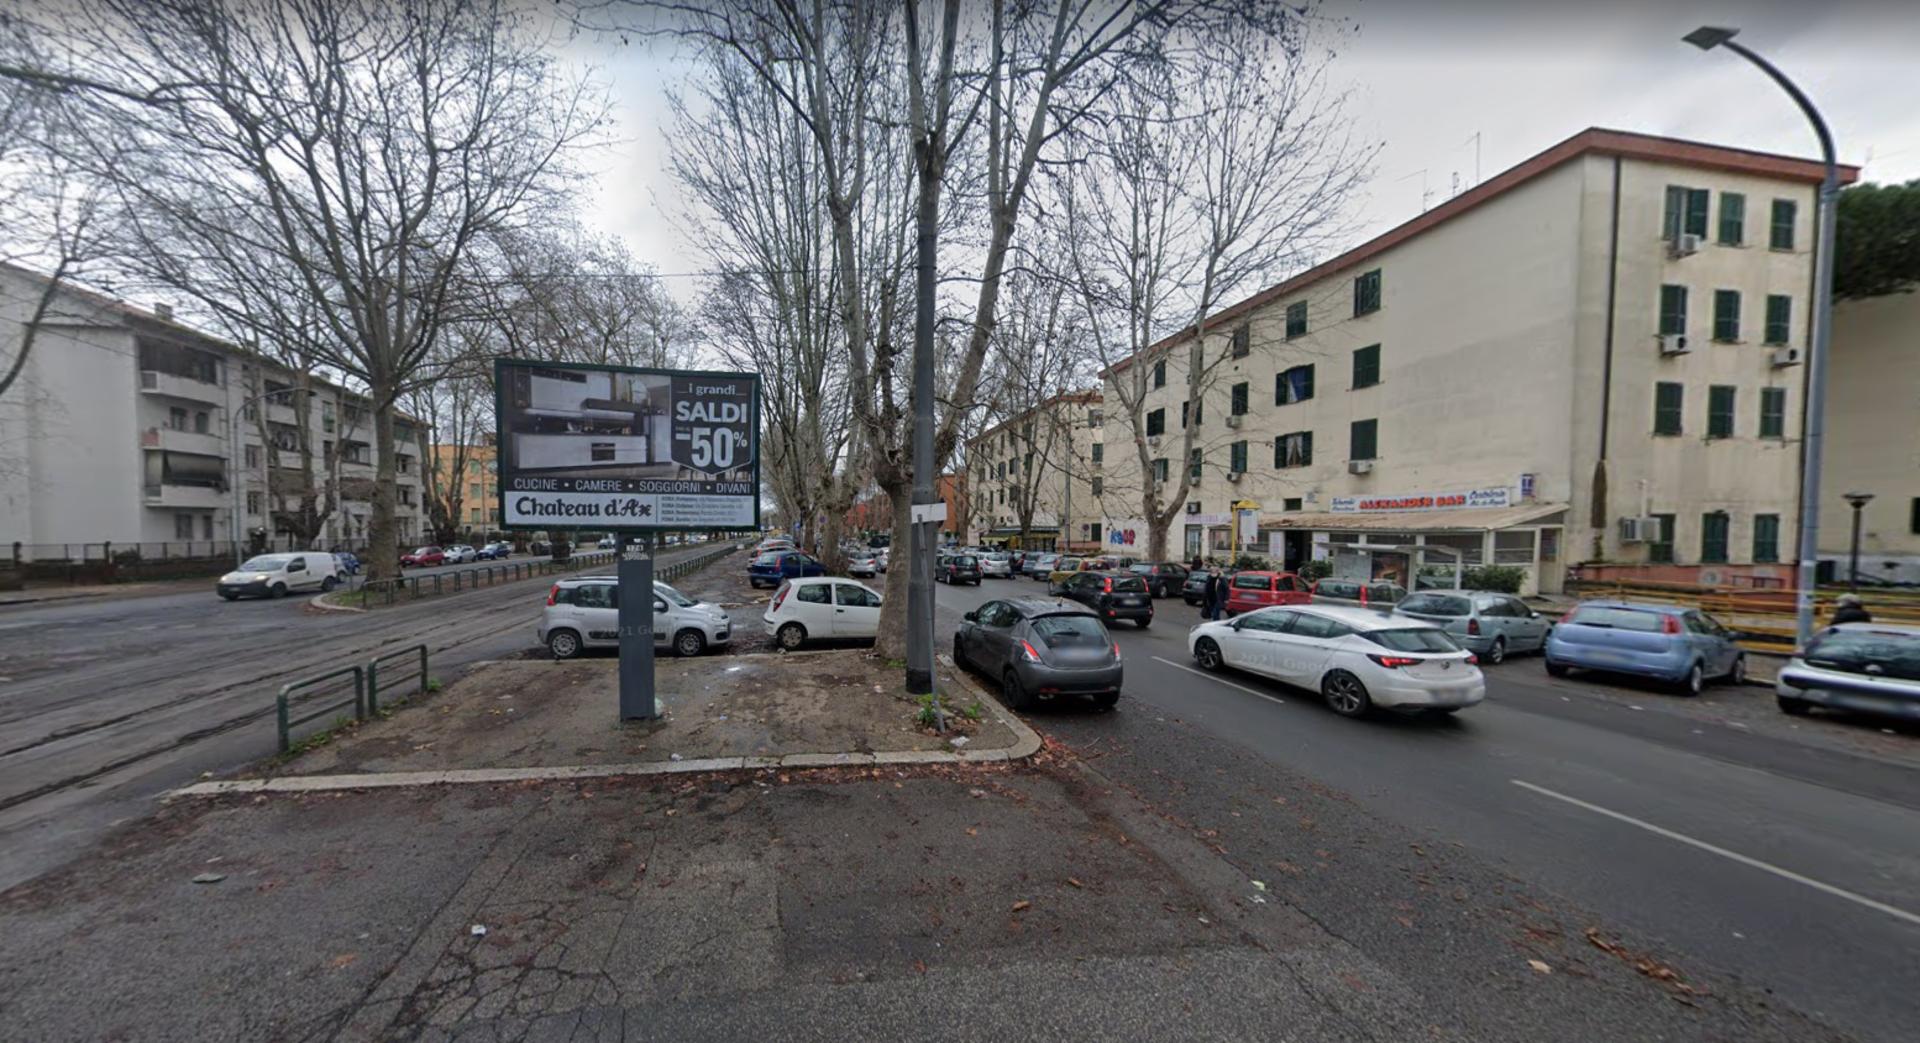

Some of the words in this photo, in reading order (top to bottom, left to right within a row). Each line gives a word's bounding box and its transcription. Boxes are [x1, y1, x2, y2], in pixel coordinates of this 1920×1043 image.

[688, 383, 693, 394] i
[695, 384, 736, 396] grandi
[675, 401, 748, 424] SALDI
[513, 478, 558, 491] CUCINE
[575, 479, 622, 492] CAMERE
[639, 480, 700, 493] SOGGIORNI
[716, 483, 751, 494] DIVANI
[515, 496, 600, 517] Chateau
[604, 498, 652, 518] d'Ax
[1436, 495, 1466, 507] BAR
